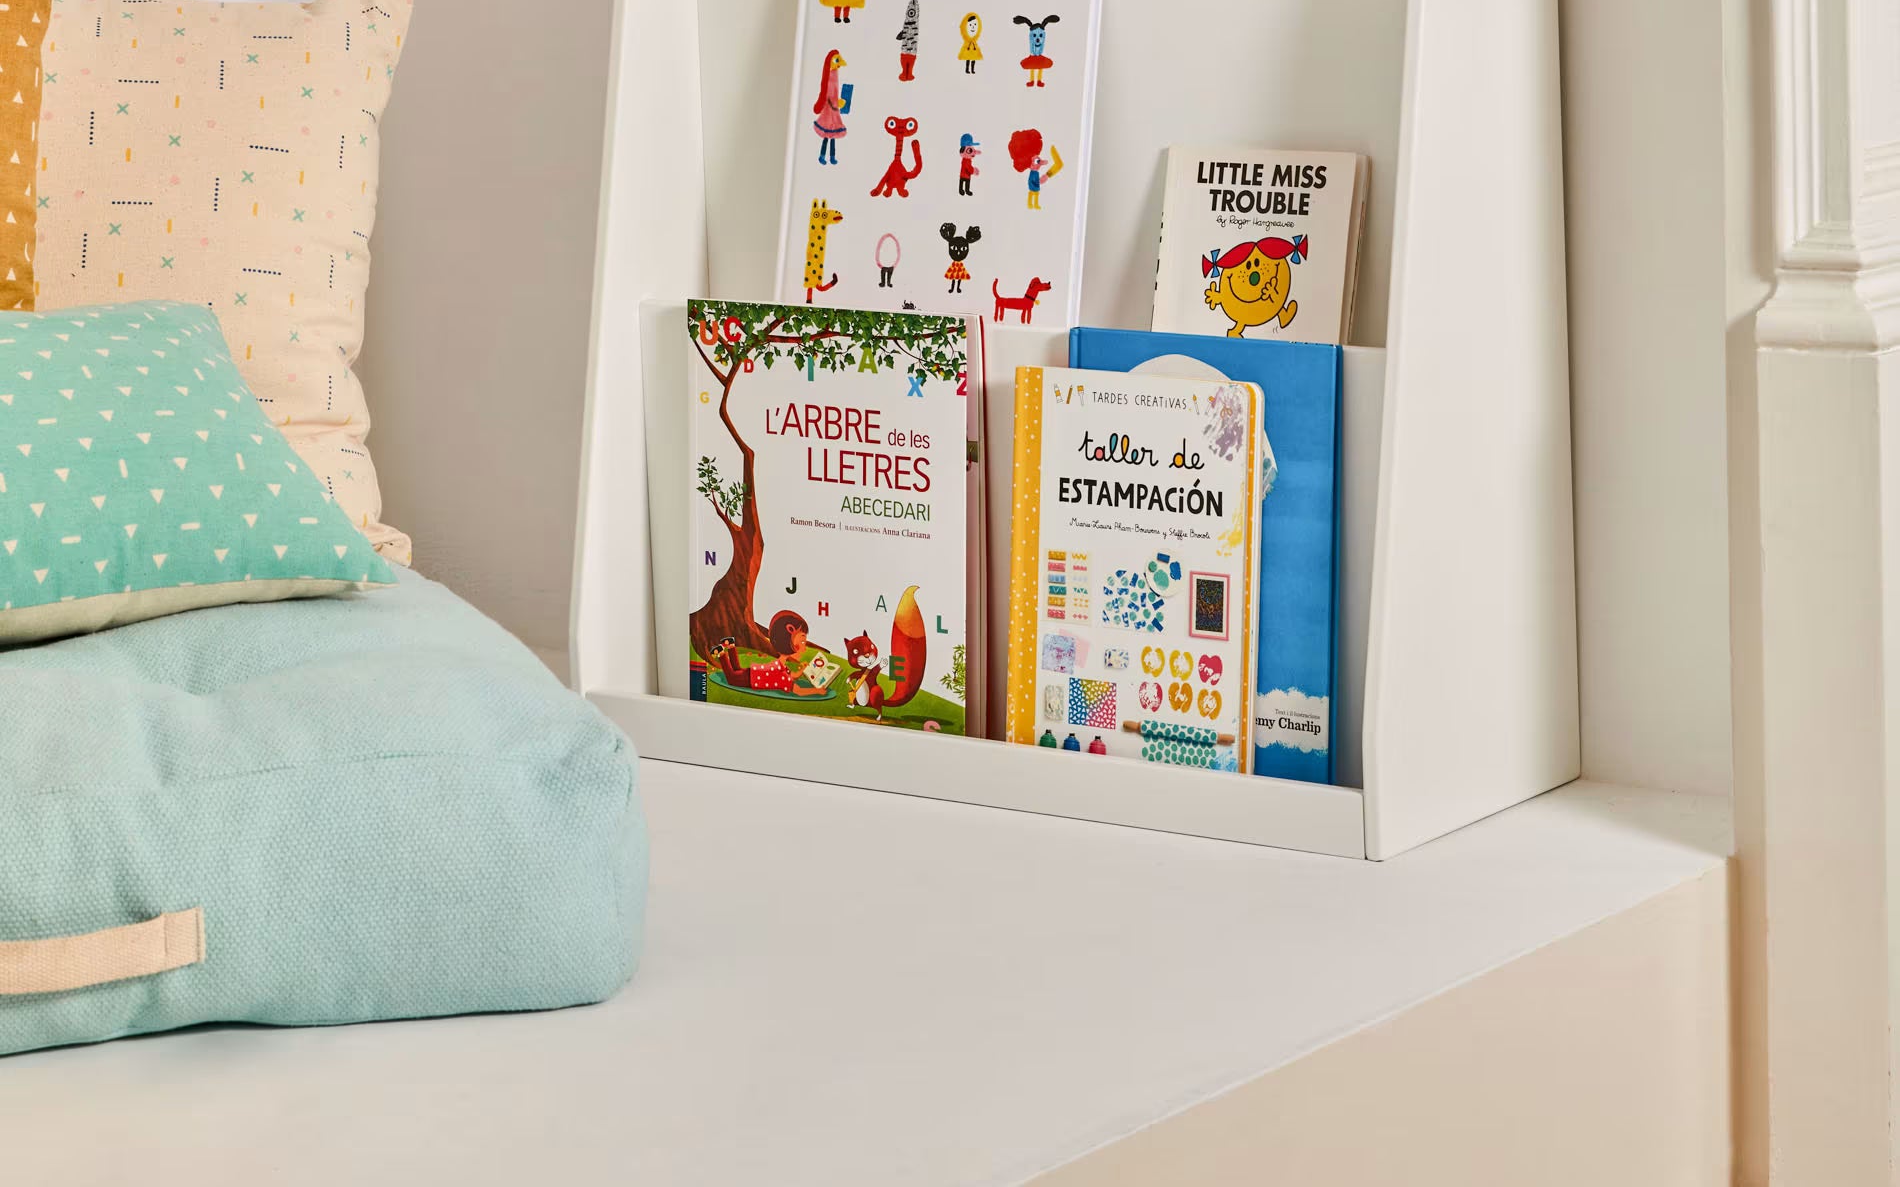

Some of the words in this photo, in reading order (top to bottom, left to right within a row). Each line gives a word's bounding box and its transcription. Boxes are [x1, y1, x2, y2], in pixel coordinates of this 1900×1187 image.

[1197, 161, 1264, 186] LITTLE
[1271, 164, 1327, 189] MISS
[1209, 189, 1311, 216] TROUBLE
[1229, 215, 1251, 230] Roger
[699, 320, 718, 346] U
[723, 316, 742, 343] C
[743, 358, 755, 373] D
[857, 347, 879, 374] A
[907, 375, 924, 398] X
[699, 391, 710, 404] G
[1092, 391, 1128, 406] TARDES
[888, 428, 906, 447] de
[910, 429, 930, 449] les
[1078, 430, 1159, 468] taller
[1169, 438, 1205, 470] de
[807, 447, 931, 493] LLETRES
[841, 495, 930, 522] ABECEDARI
[790, 517, 813, 527] Ramon
[814, 520, 836, 529] Besora
[882, 527, 900, 536] Anna
[901, 529, 931, 540] Clariana
[704, 550, 717, 566] N
[785, 577, 797, 595] J
[818, 601, 829, 617] H
[875, 594, 887, 613] A
[936, 615, 948, 634] L
[888, 655, 906, 682] E
[1278, 717, 1321, 735] Charlip
